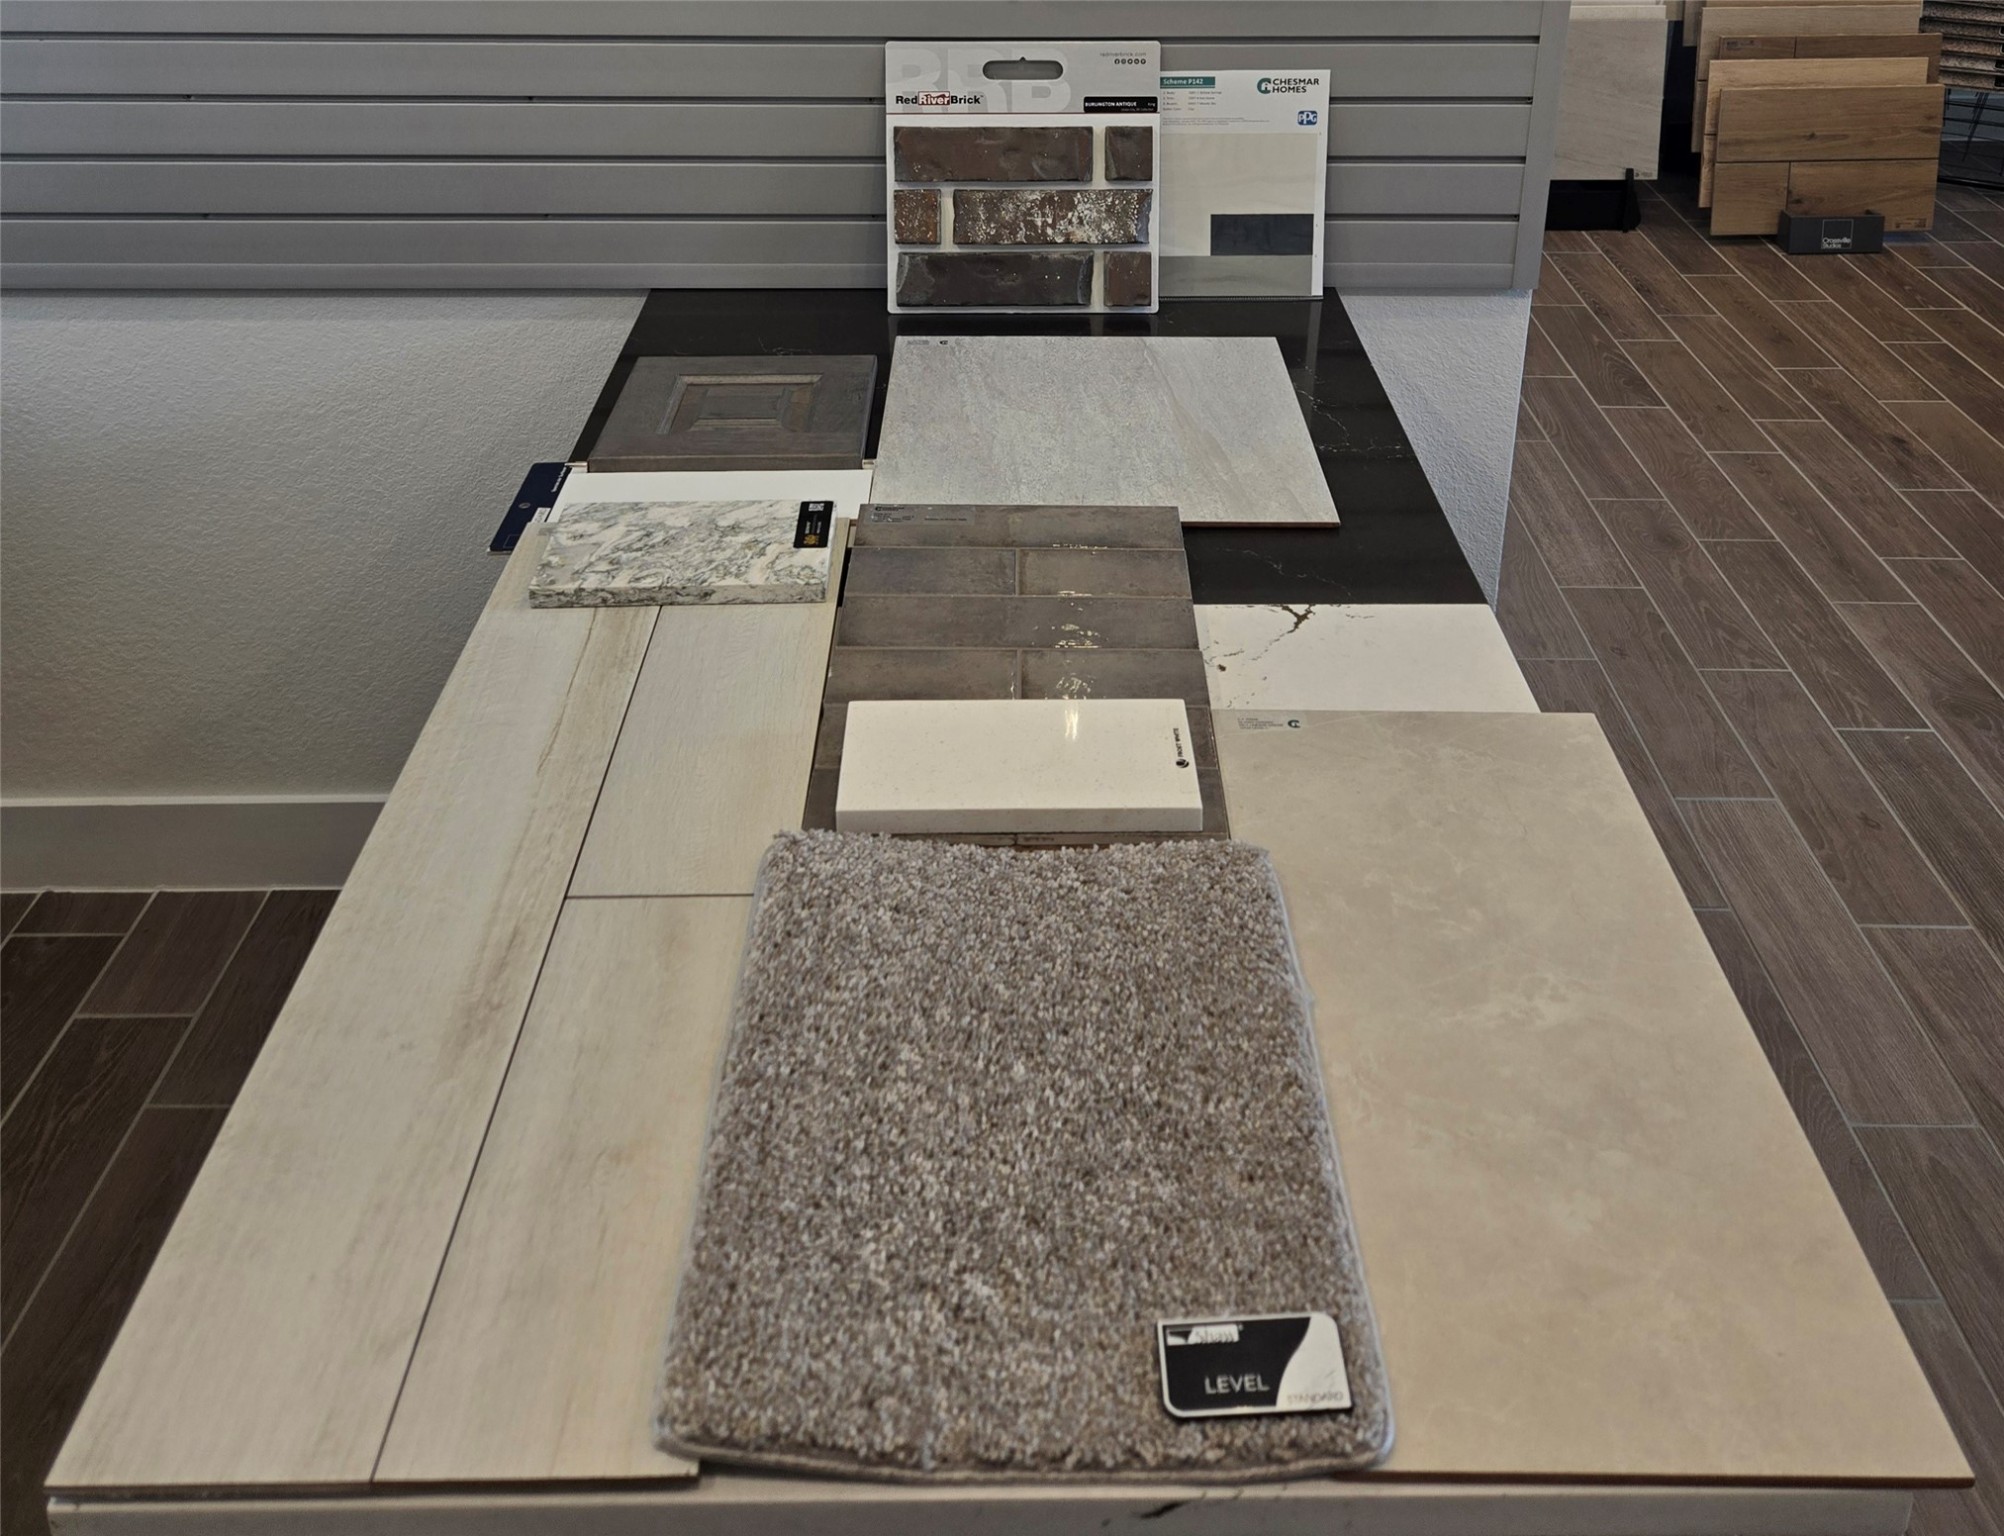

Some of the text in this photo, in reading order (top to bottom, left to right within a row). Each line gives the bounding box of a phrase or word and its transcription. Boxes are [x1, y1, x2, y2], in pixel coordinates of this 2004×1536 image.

[1272, 78, 1320, 86] CHESMAR
[1272, 86, 1307, 94] HOMES
[1298, 111, 1318, 125] PPG
[1204, 1373, 1271, 1395] LEVEL
